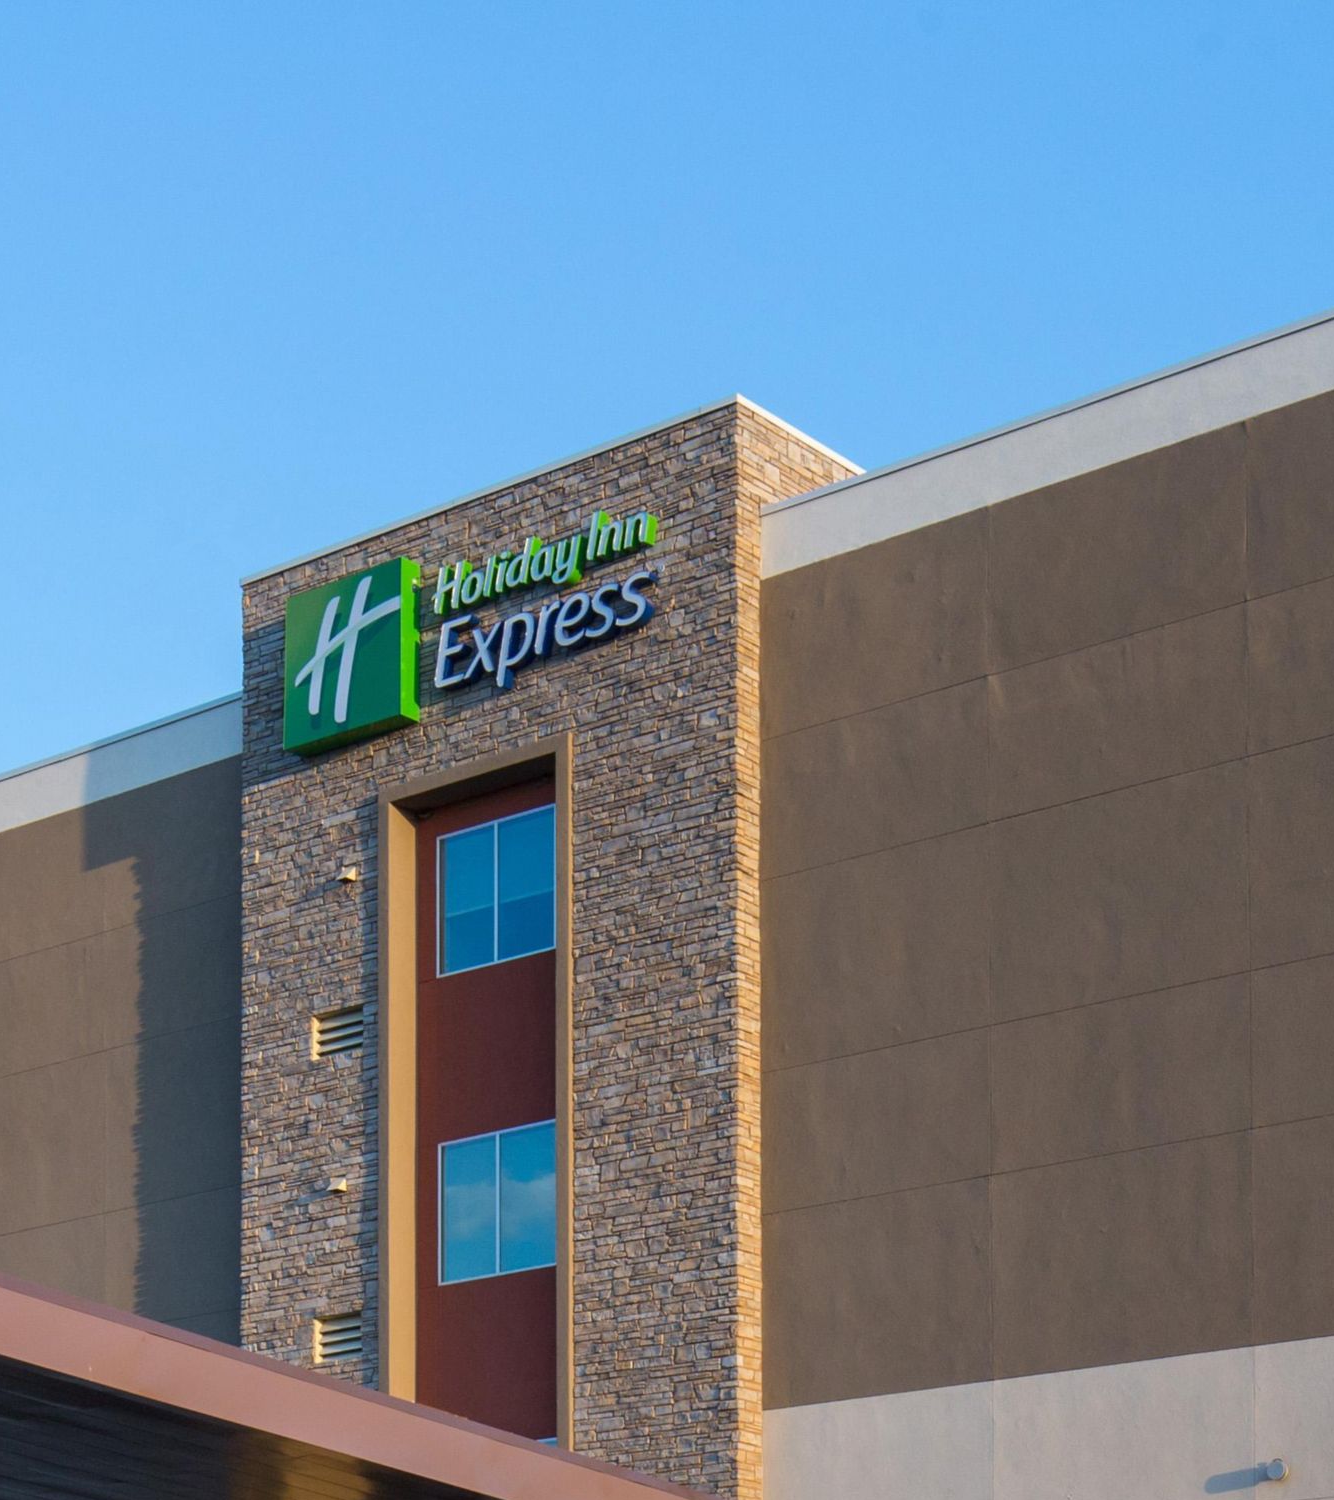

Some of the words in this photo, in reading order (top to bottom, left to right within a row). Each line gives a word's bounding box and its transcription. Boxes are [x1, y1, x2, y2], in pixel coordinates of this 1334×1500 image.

[433, 534, 583, 615] Holiday
[586, 510, 654, 561] Inn
[434, 571, 655, 689] Express
